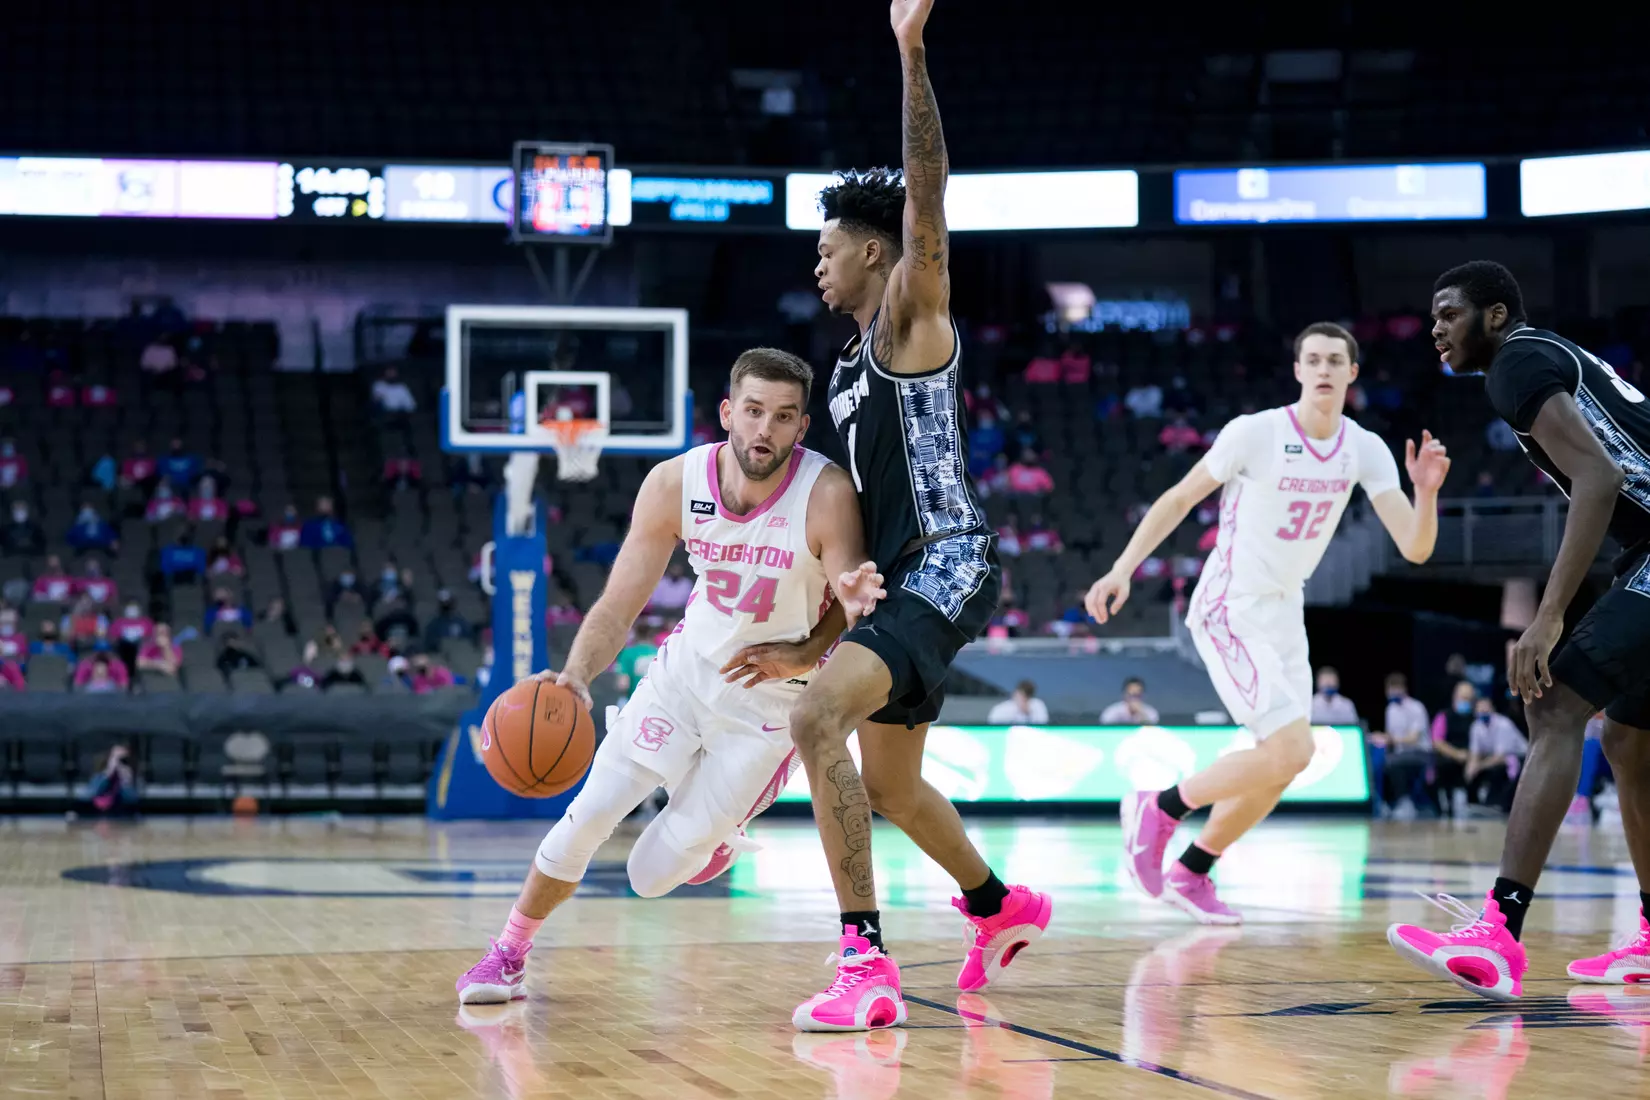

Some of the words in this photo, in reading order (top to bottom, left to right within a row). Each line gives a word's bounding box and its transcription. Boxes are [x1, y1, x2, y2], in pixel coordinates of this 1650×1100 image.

[693, 502, 713, 512] BLM
[1276, 500, 1334, 541] 32
[687, 538, 795, 570] CREIGHTON
[705, 569, 780, 624] 24
